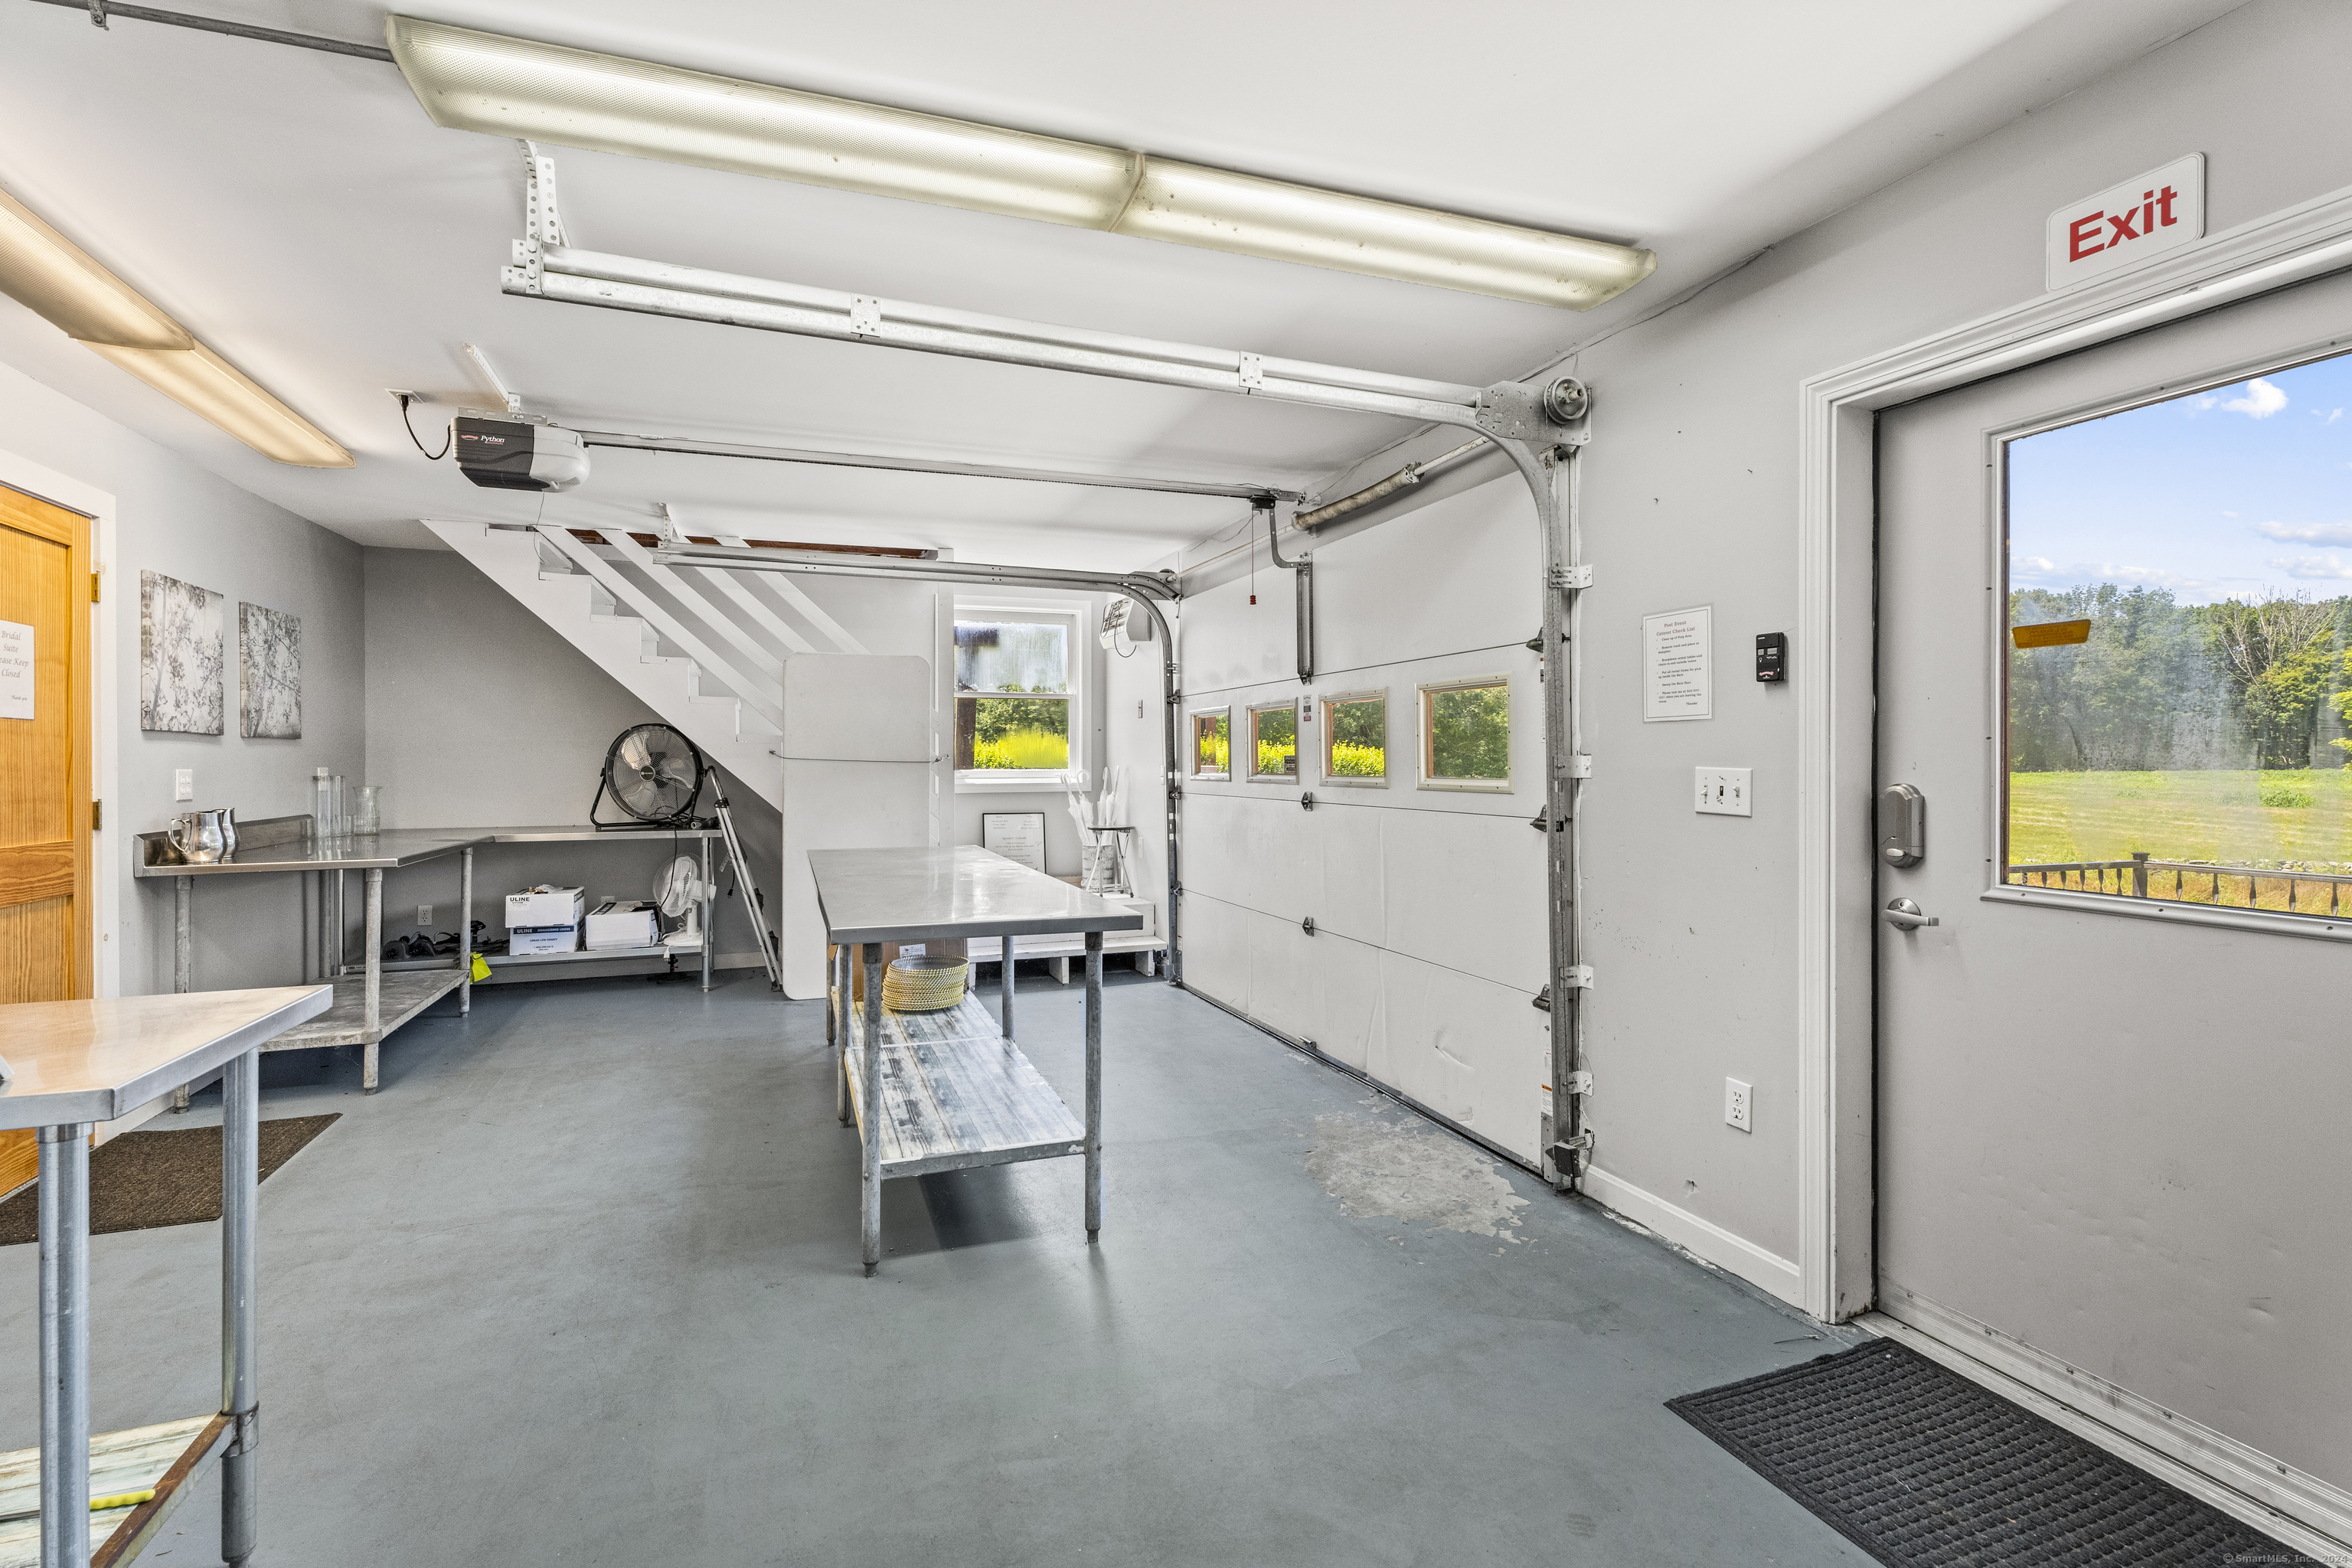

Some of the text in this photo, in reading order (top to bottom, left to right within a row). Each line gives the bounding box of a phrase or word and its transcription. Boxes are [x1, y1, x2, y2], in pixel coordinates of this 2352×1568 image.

[2069, 185, 2177, 263] Exit
[481, 435, 505, 443] Python
[2, 630, 21, 640] Bridal
[3, 644, 19, 652] Suite
[0, 655, 29, 669] ease Keep
[2, 668, 22, 678] Closed
